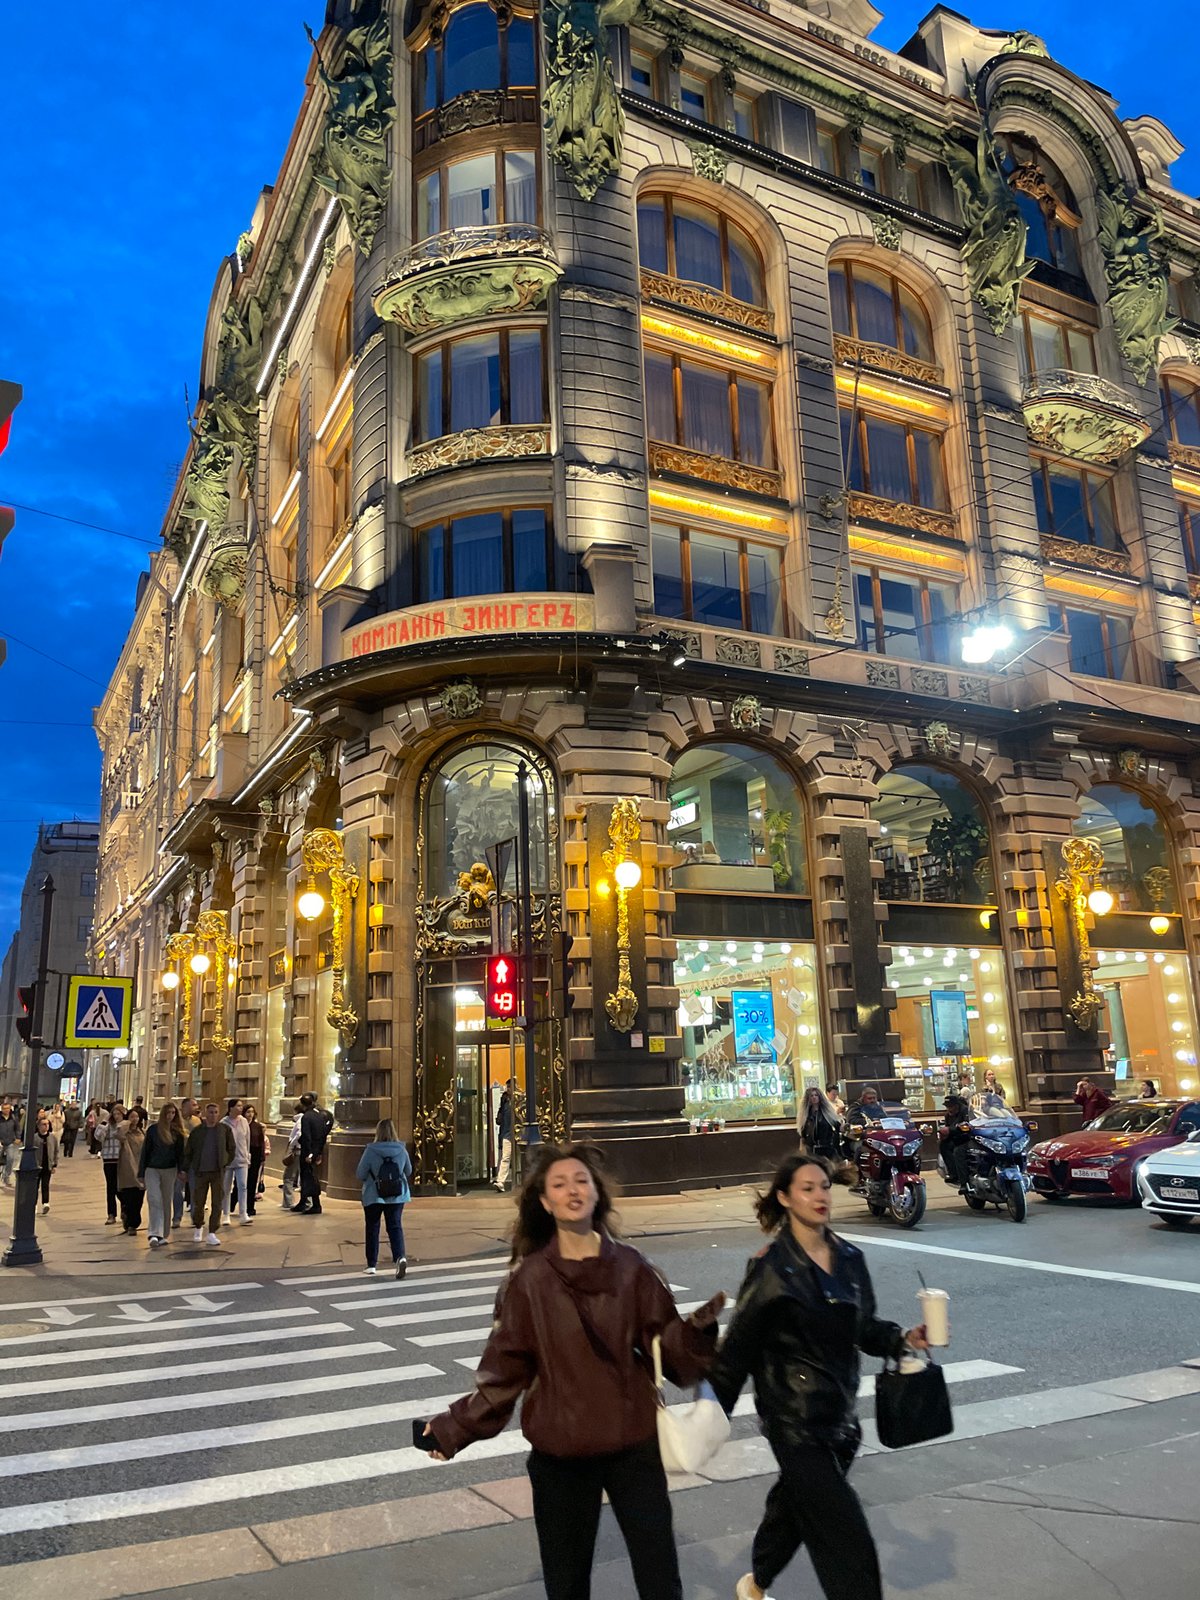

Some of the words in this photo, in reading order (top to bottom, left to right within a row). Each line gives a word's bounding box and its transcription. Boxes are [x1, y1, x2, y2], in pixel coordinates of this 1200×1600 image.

[352, 611, 446, 657] КОМПАНІЯ
[463, 603, 575, 631] ЗИНГЕРЪ
[494, 992, 512, 1011] 43
[740, 1010, 769, 1023] -30%
